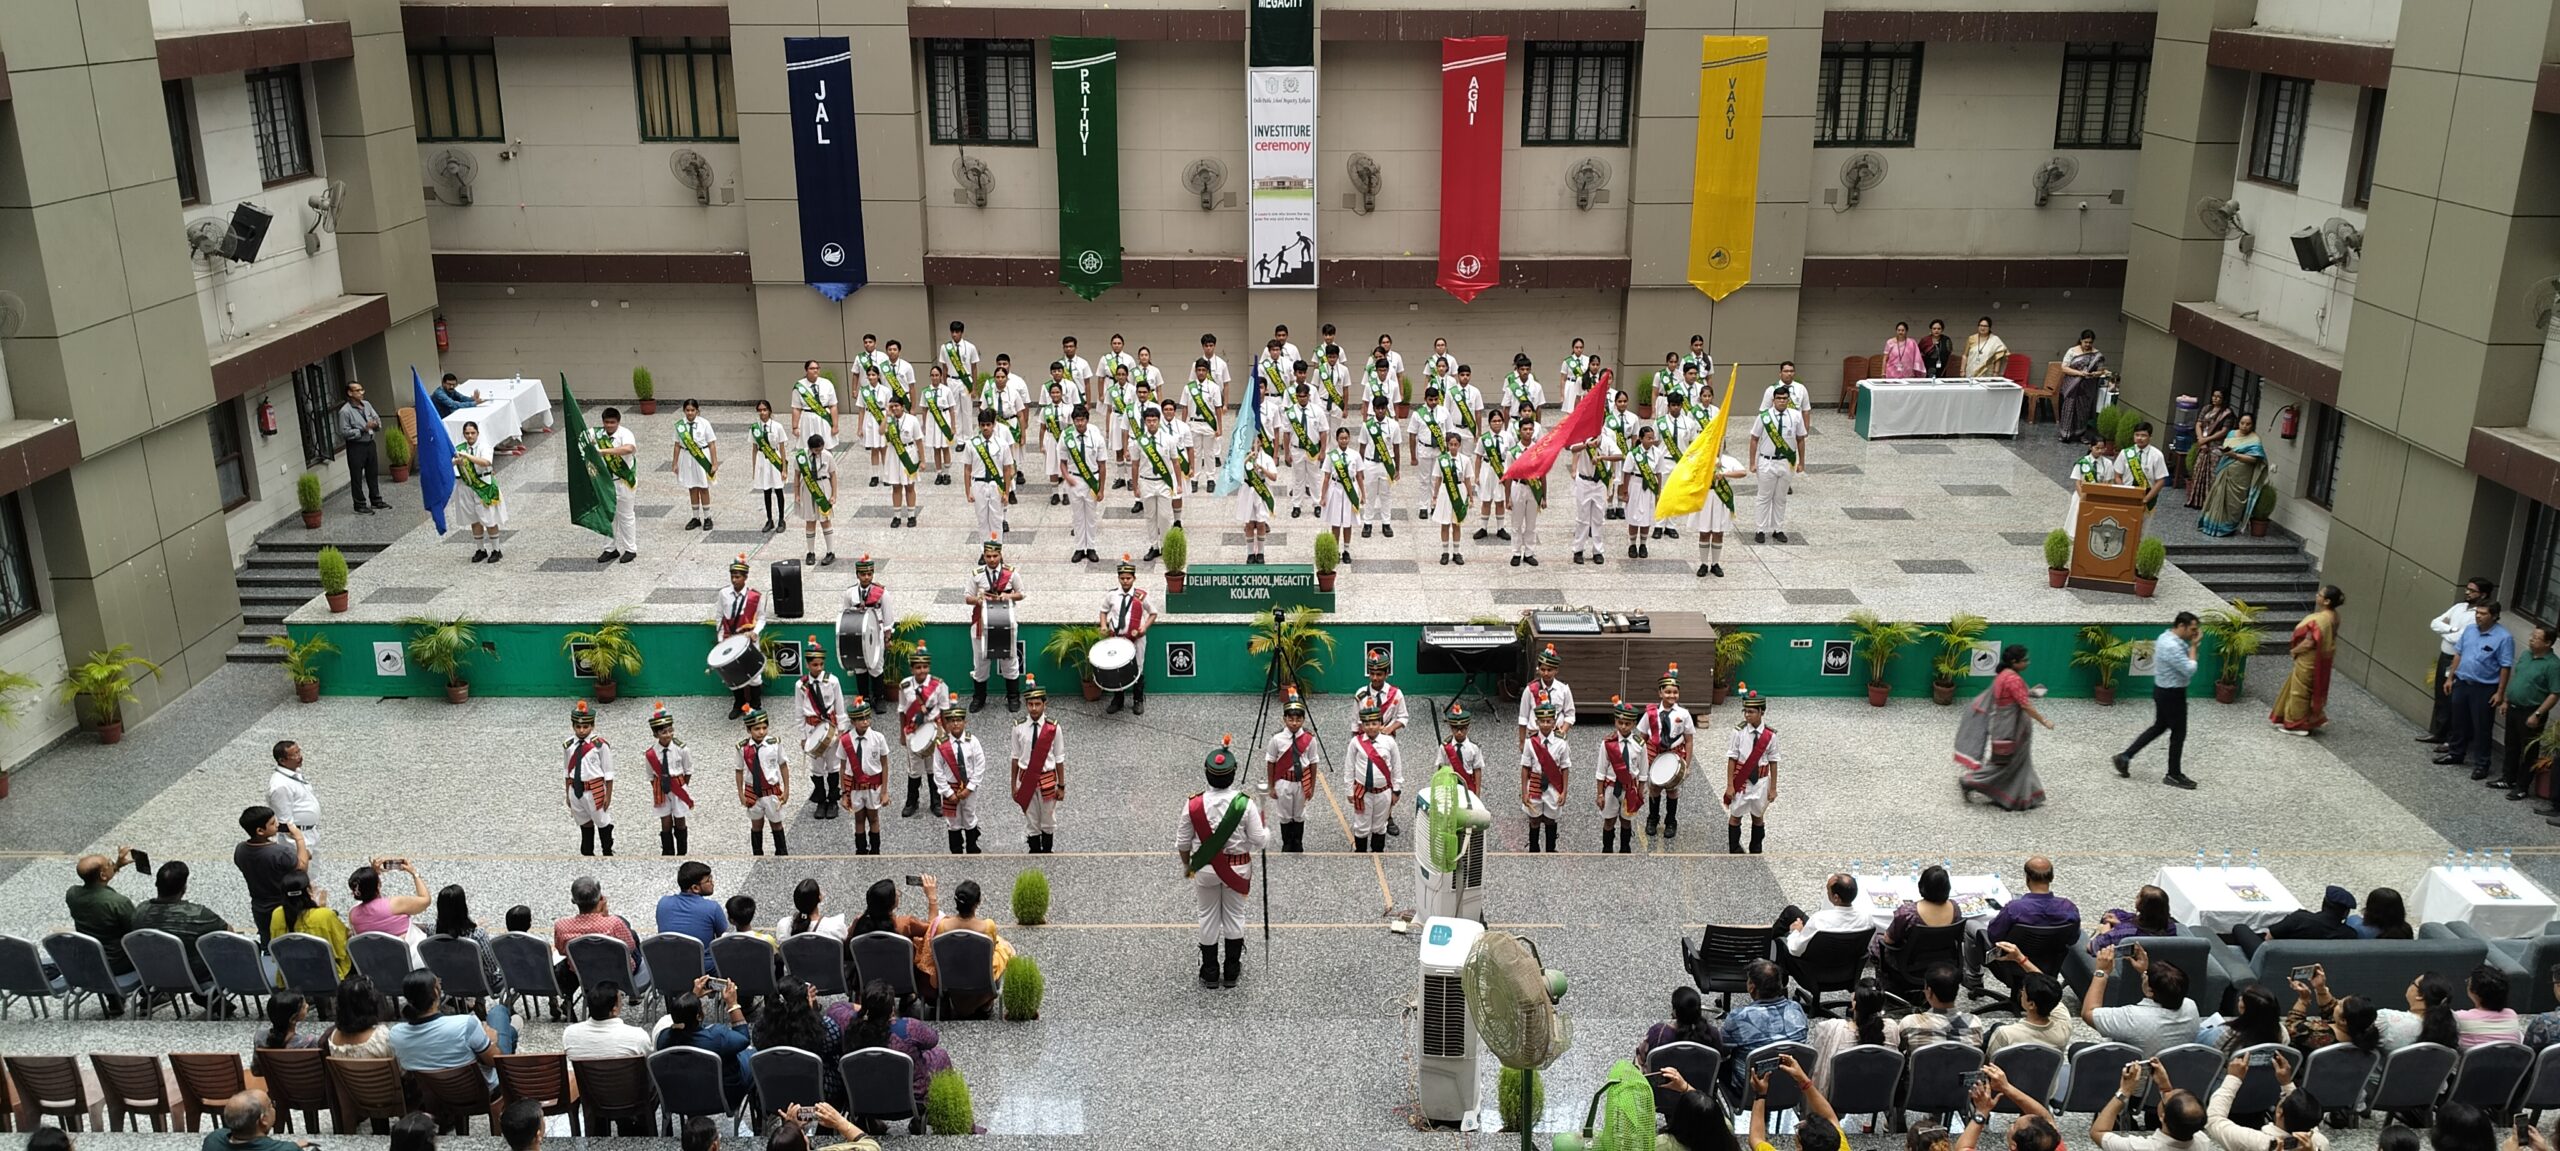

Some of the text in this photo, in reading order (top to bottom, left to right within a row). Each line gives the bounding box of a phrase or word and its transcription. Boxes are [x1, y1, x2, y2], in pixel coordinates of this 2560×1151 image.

[814, 80, 830, 144] JAL
[1080, 69, 1090, 156] PRITHVI
[1468, 76, 1479, 125] AGNI
[1725, 78, 1737, 140] VAAYU
[1254, 125, 1311, 137] INVESTITURE
[1255, 141, 1311, 154] ceremony
[1145, 443, 1168, 475] HEAD BOY
[1333, 460, 1354, 492] HEAD GIRL
[1189, 576, 1211, 586] DELHI
[1213, 576, 1239, 586] PUBLIC
[1231, 588, 1270, 599] KOLKATA
